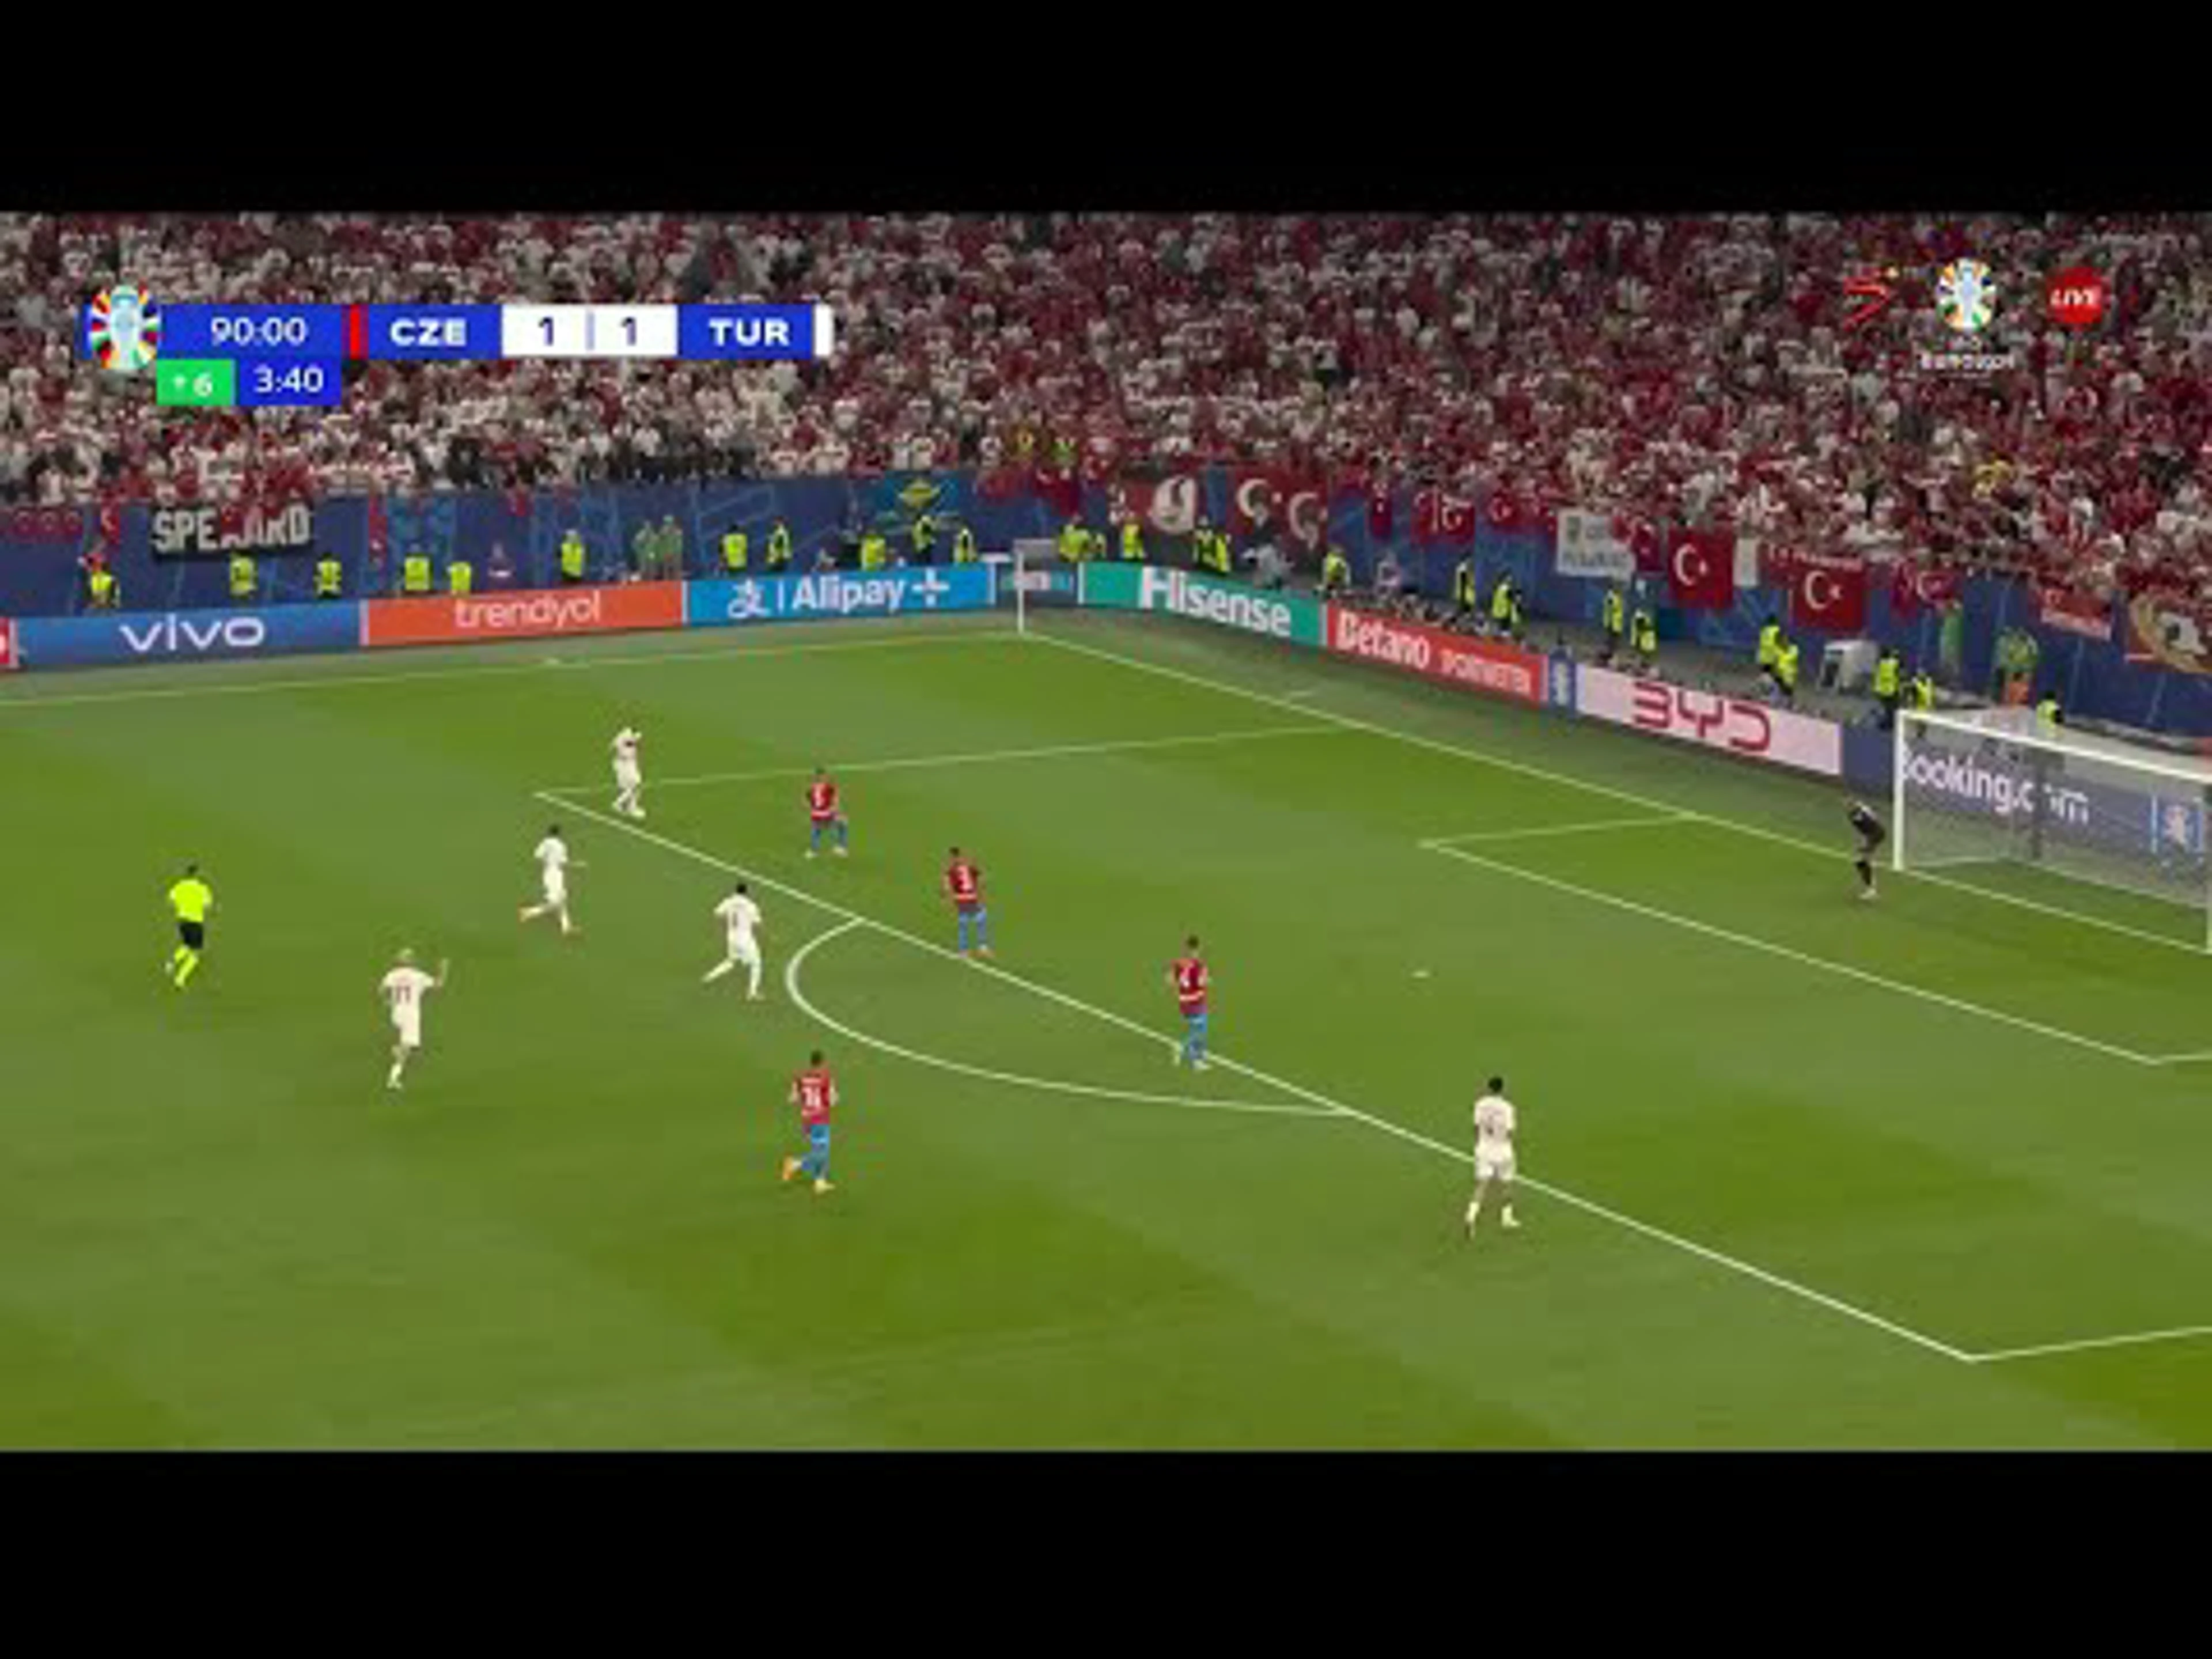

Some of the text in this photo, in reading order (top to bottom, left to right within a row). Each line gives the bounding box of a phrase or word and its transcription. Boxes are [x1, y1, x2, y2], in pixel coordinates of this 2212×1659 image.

[455, 596, 601, 631] trendyol
[1138, 565, 1291, 637] Hisense
[120, 614, 266, 652] vivo
[1335, 611, 1431, 671] Betano
